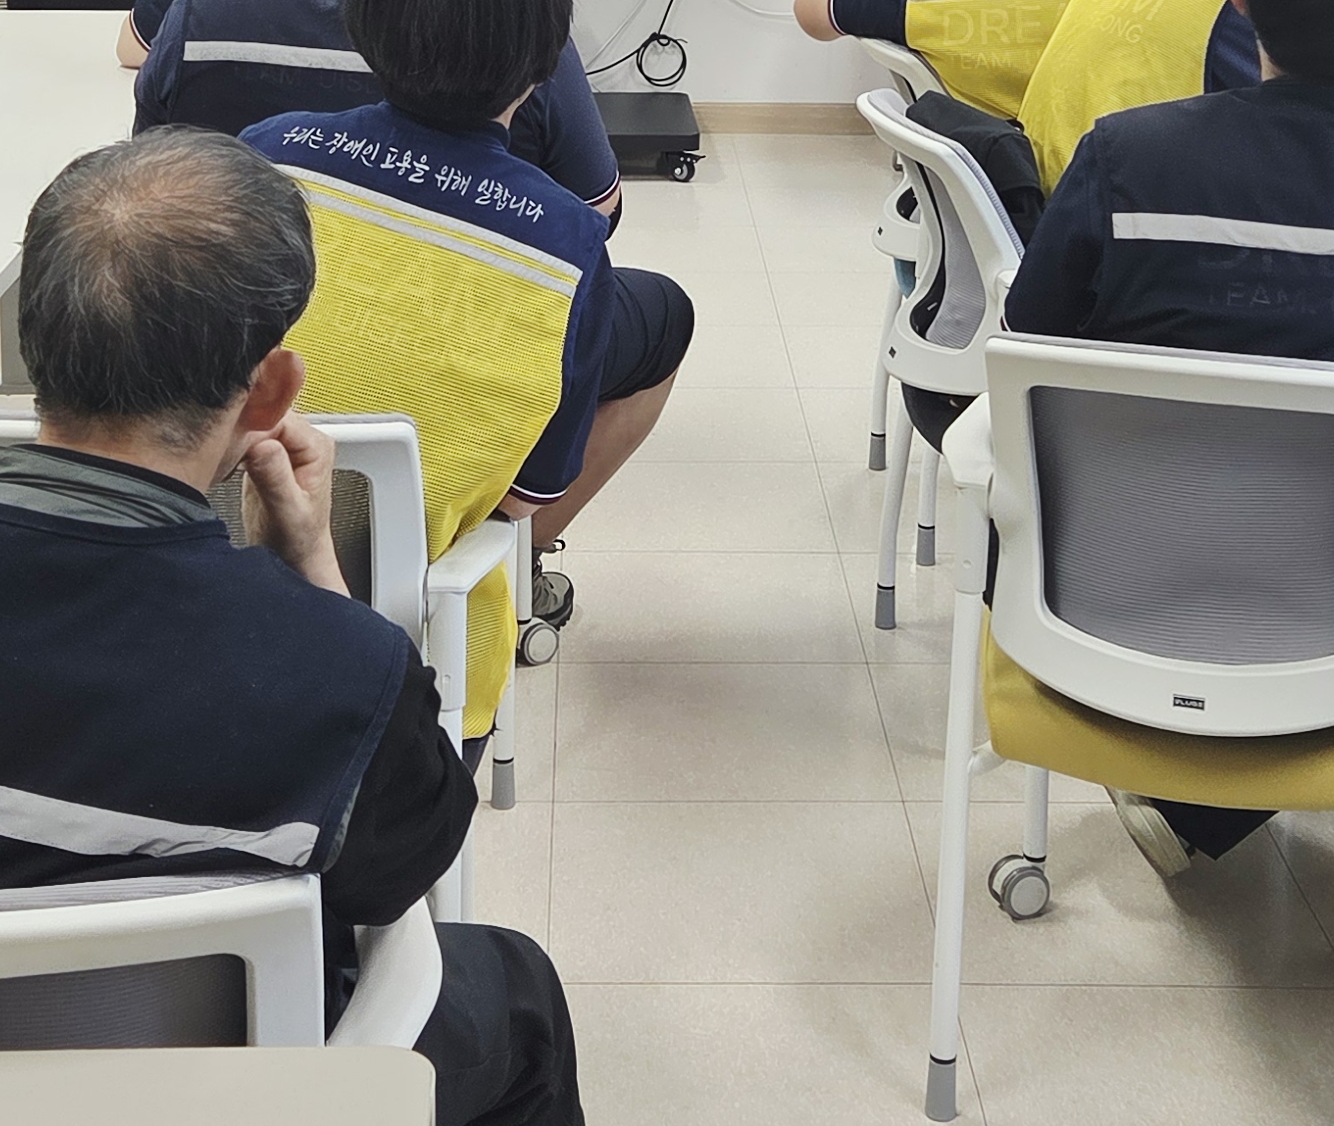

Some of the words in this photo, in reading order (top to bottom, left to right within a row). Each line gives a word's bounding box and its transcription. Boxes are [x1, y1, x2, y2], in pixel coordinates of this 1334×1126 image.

[942, 3, 1043, 46] DRE
[283, 126, 324, 149] 우리는
[325, 131, 380, 168] 장애인
[434, 165, 472, 196] 위해
[475, 178, 544, 223] 일합니다
